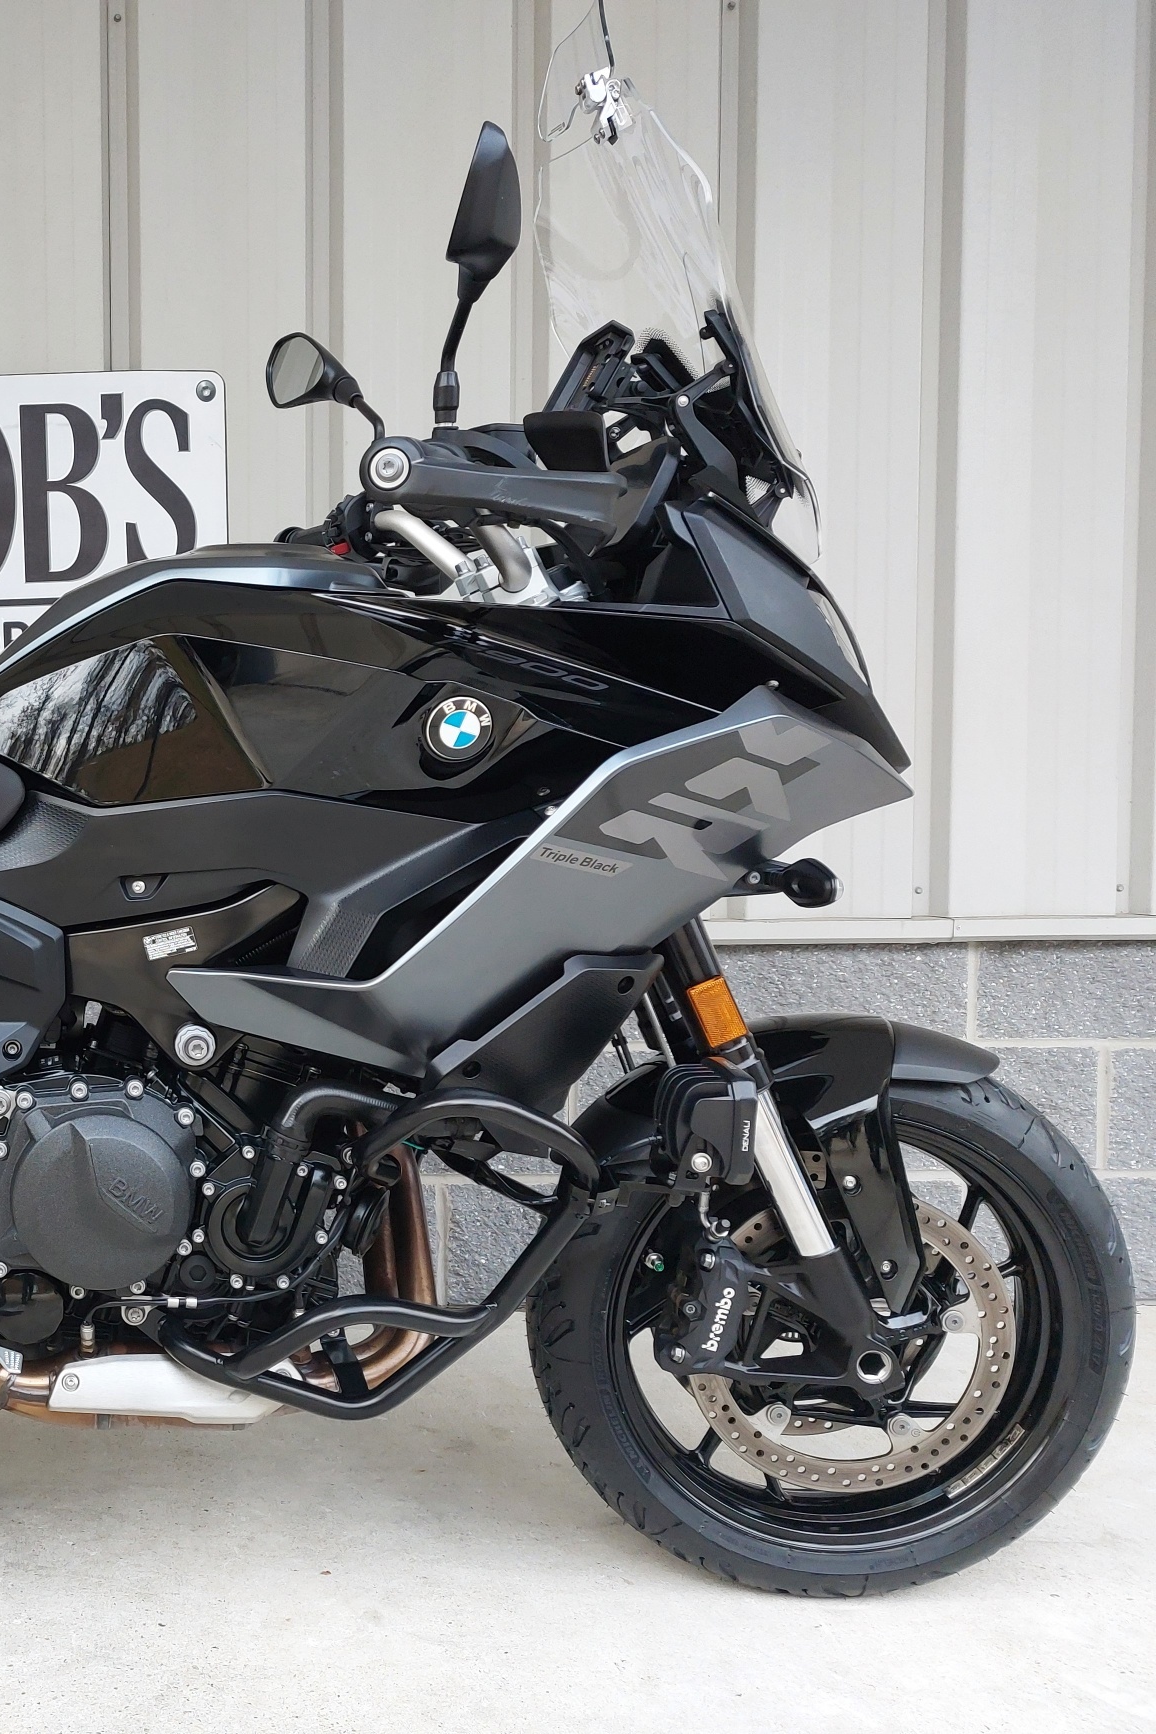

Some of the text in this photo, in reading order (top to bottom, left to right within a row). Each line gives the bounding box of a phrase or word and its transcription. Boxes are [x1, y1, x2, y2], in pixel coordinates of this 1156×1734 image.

[443, 700, 491, 727] BMW
[540, 847, 619, 873] Triple Black
[742, 1120, 751, 1151] DENALI
[109, 1177, 163, 1220] BMW
[701, 1287, 735, 1352] brembo
